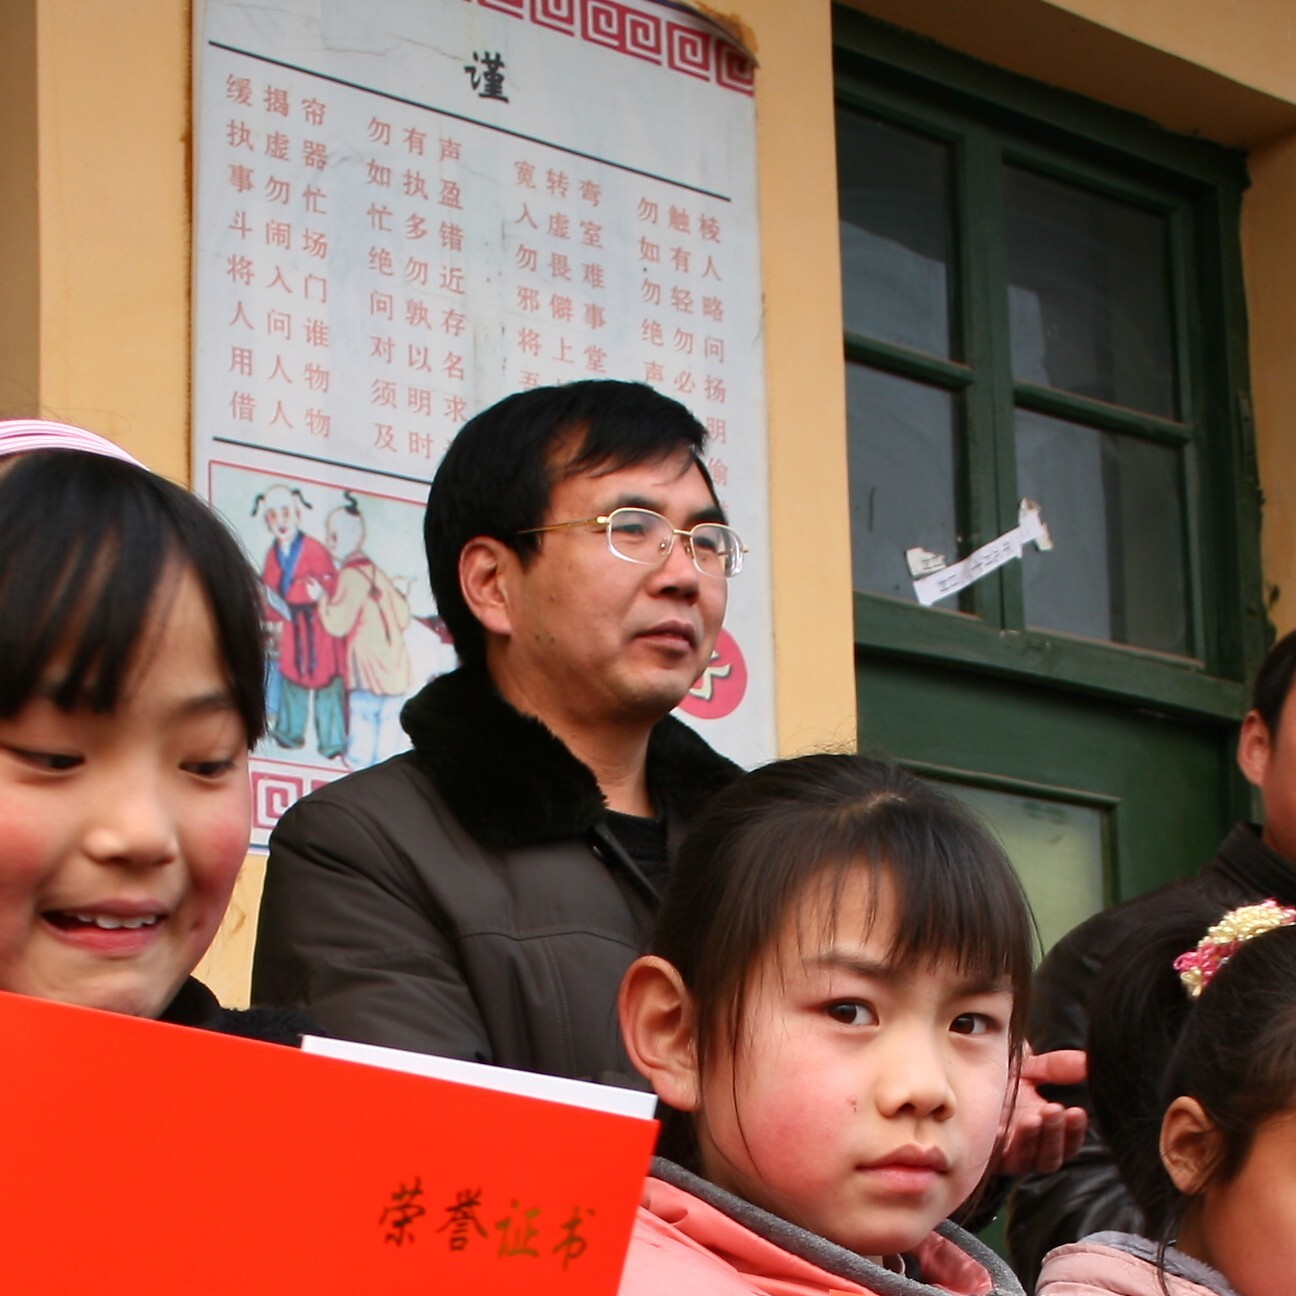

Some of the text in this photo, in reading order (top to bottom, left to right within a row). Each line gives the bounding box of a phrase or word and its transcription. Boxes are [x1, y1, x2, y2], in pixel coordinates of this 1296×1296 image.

[464, 51, 510, 103] 谨
[226, 73, 721, 244] 缓揭帘 勿有声 宽转弯 勿触棱
[226, 119, 722, 282] 执虚器 如执盈 入虚室 如有人
[227, 163, 725, 322] 事勿忙 忙多错 勿畏难 勿轻略
[228, 210, 725, 363] 斗闹场 绝勿近 邪僻事 绝勿问
[226, 253, 727, 404] 将入门 问孰存 将上堂 声必扬
[228, 300, 330, 348] 人问谁
[370, 335, 466, 381] 对以名
[228, 346, 330, 393] 用人物
[371, 378, 468, 423] 须明求
[229, 390, 453, 460] 借人物 及时
[379, 1176, 597, 1271] 荣誉证书
